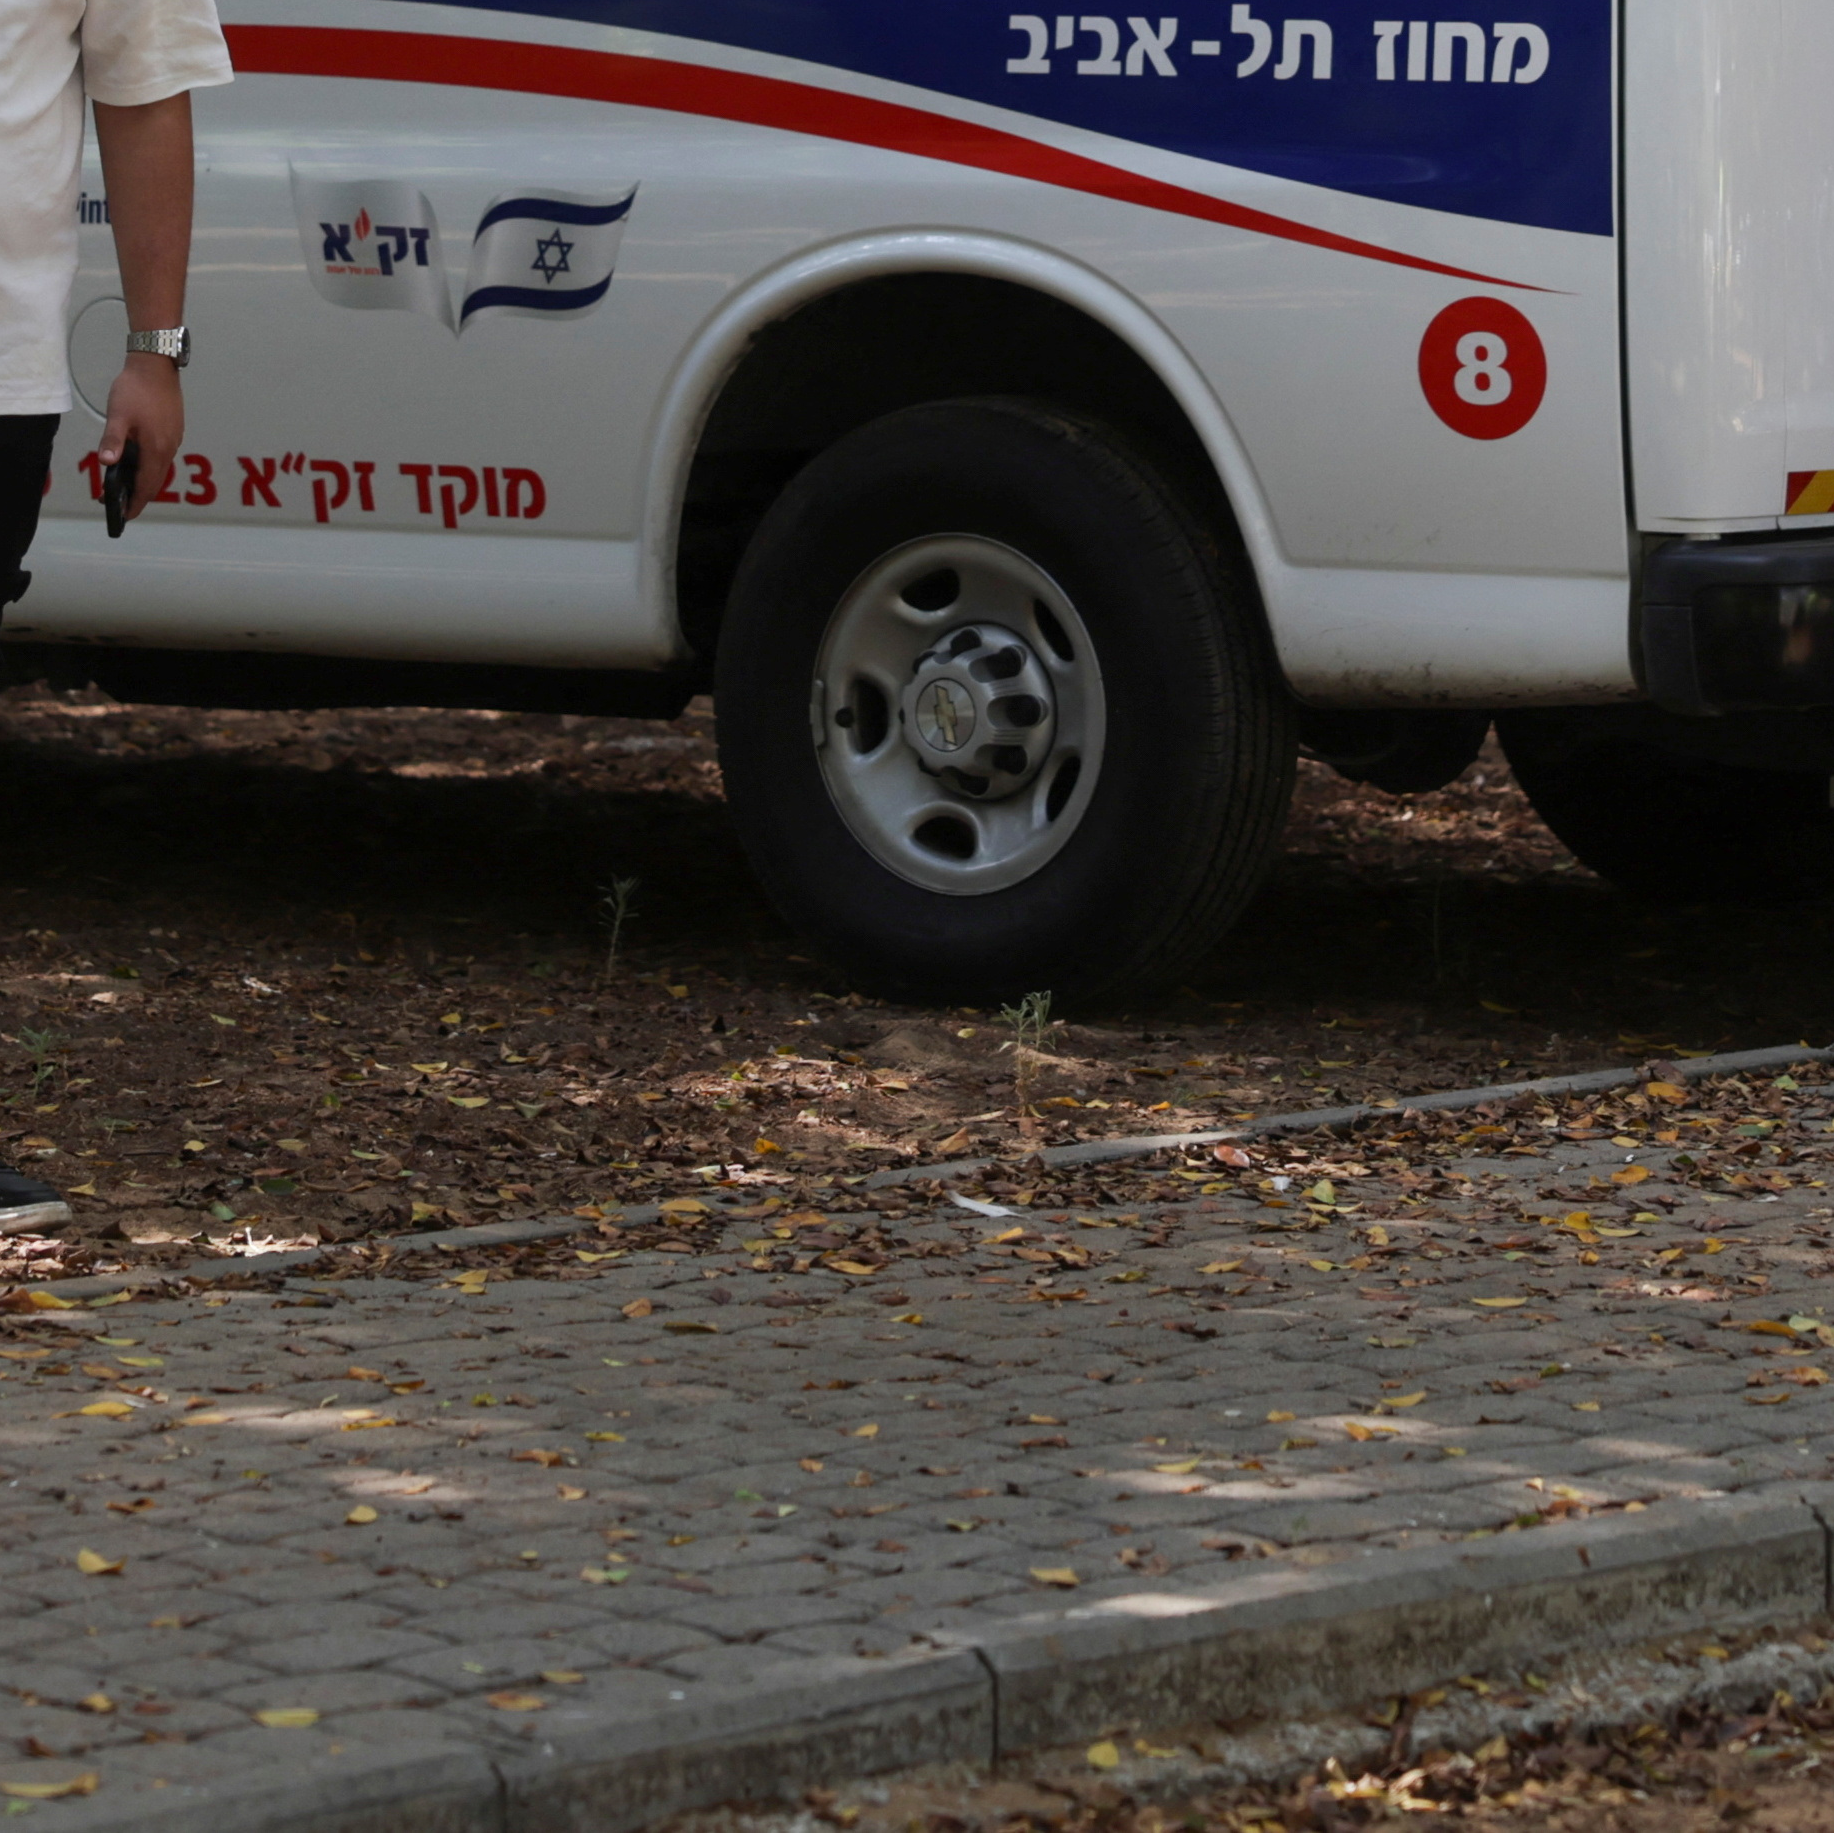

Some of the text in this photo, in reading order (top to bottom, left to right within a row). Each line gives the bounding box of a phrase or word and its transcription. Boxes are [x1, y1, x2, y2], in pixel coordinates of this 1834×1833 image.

[1006, 3, 1550, 85] מחוז תל-אביב
[1454, 331, 1513, 406] 8
[399, 463, 547, 529] מוקד
